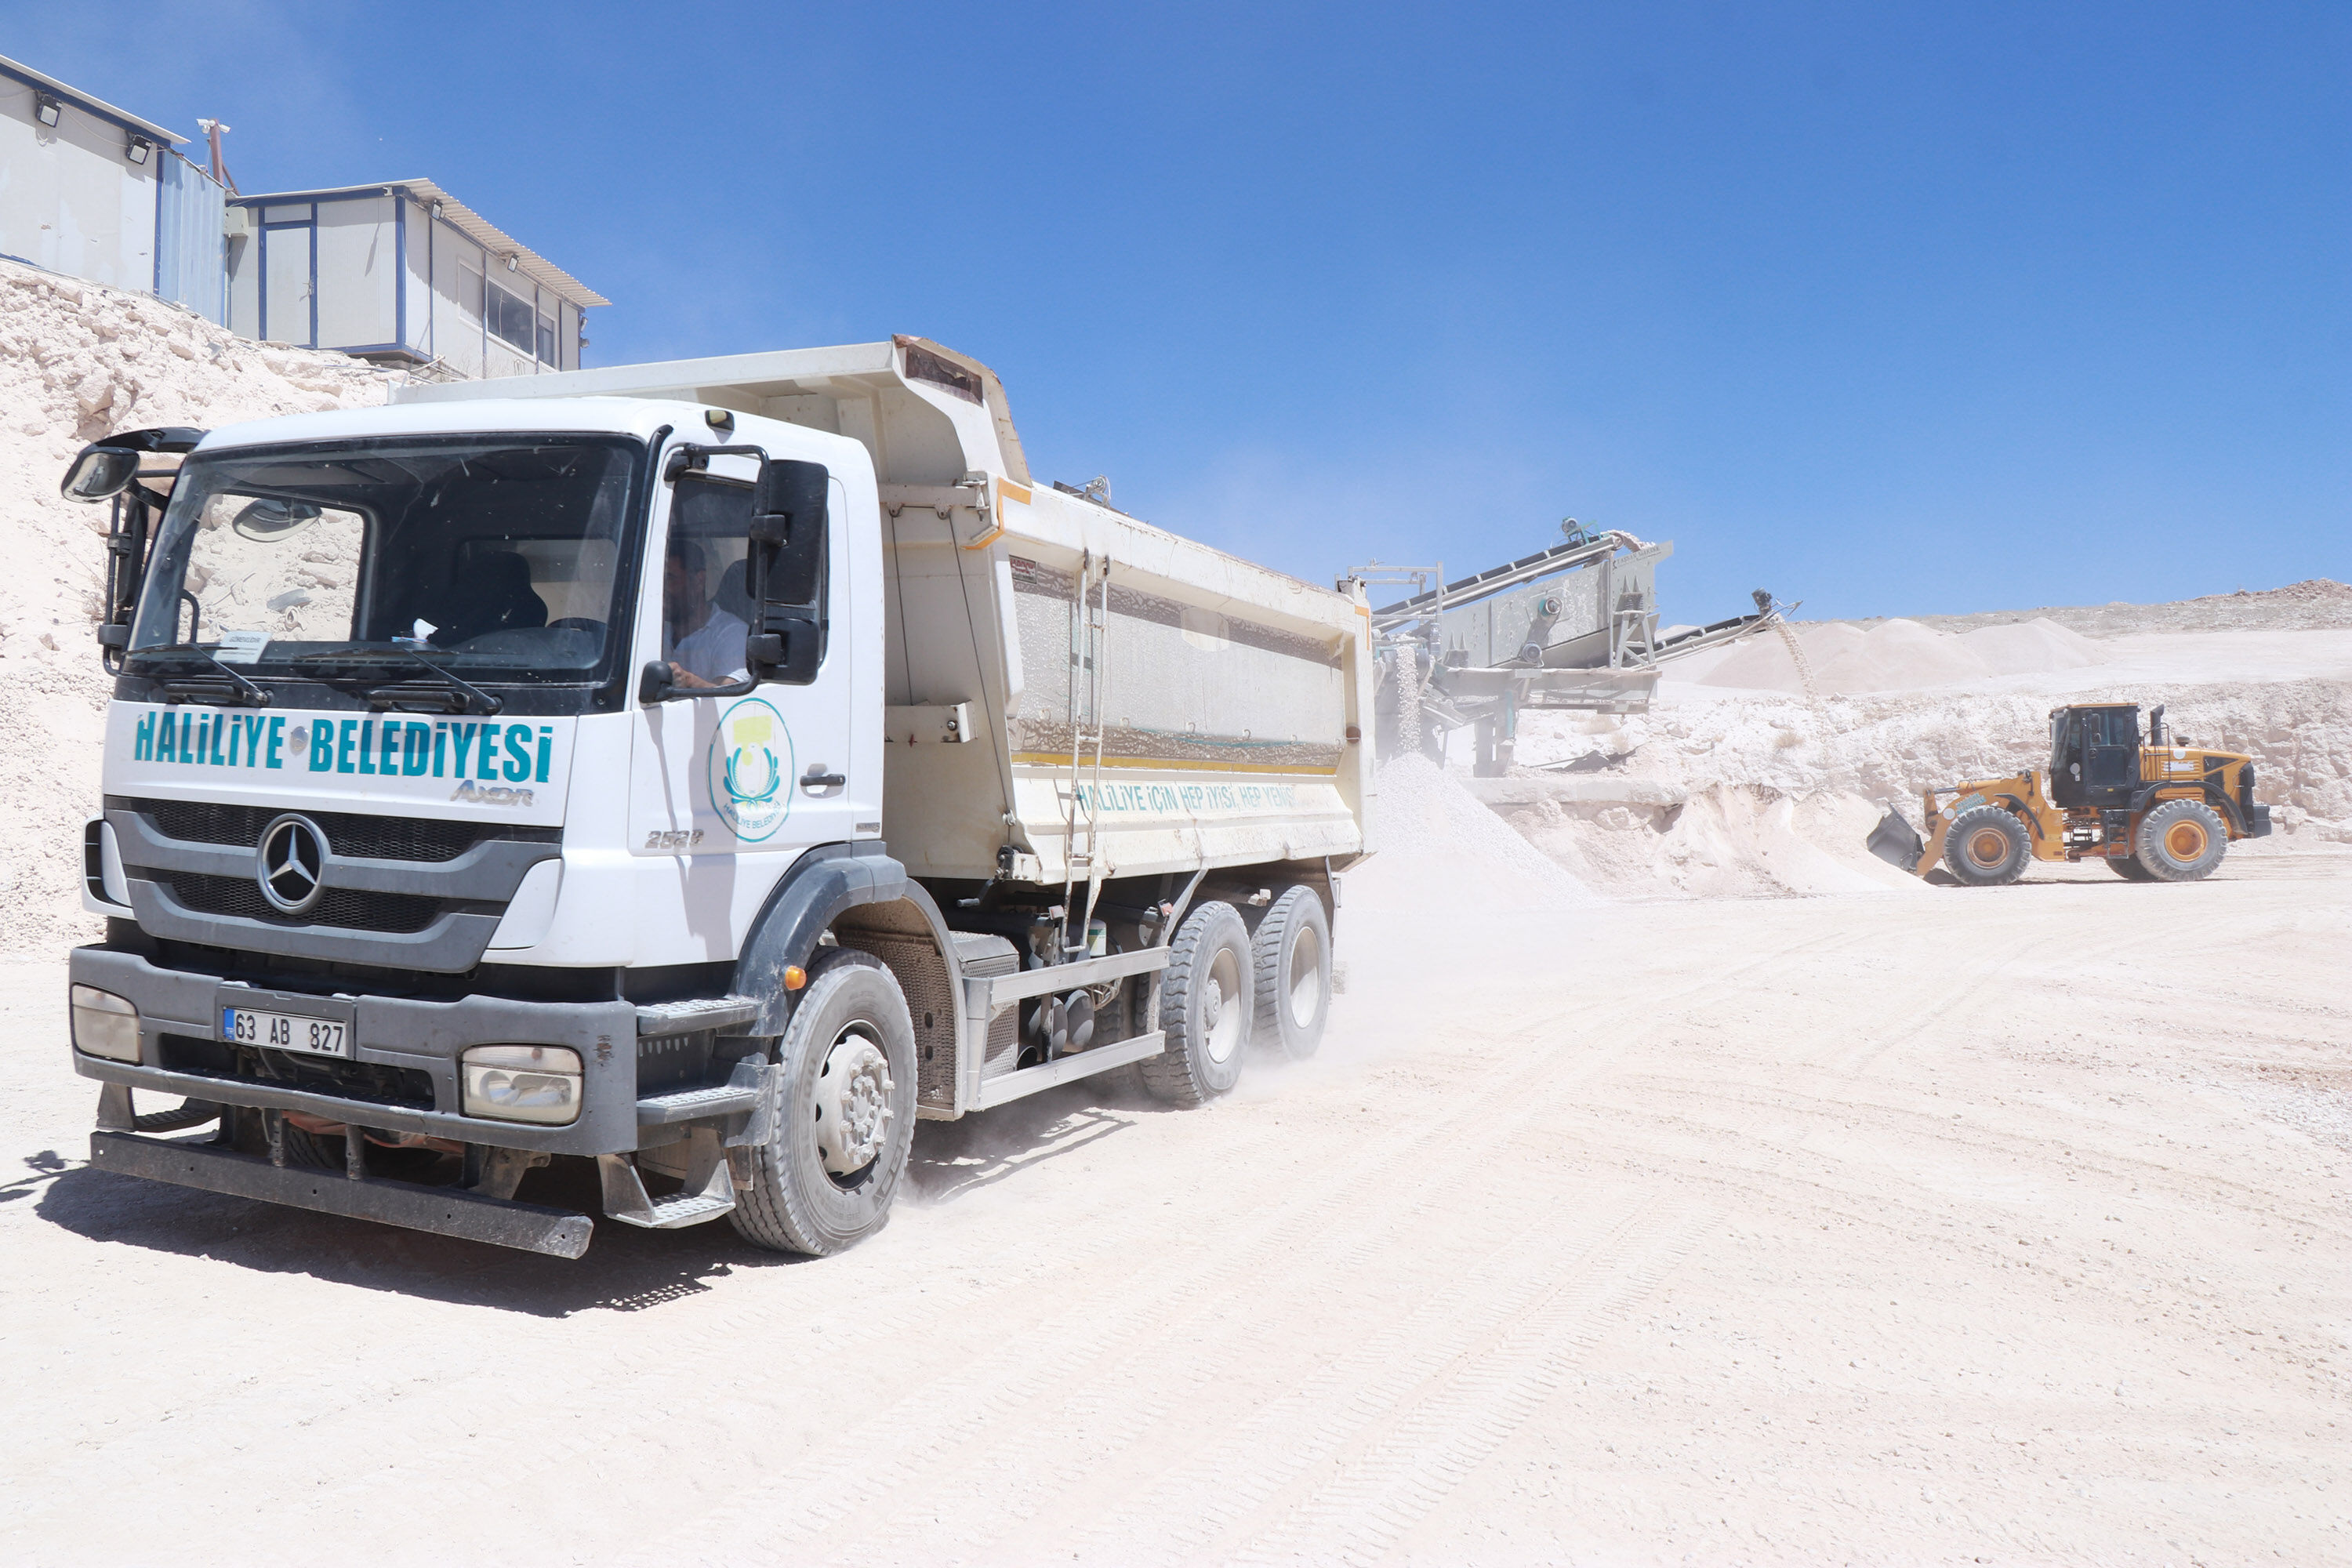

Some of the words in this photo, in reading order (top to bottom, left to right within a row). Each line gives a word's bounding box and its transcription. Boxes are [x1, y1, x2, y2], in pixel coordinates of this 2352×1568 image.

[135, 711, 285, 769] HALİLİYE
[309, 718, 553, 782] BELEDİYESİ
[1146, 786, 1179, 815] İÇİN
[1178, 786, 1203, 810] HEP
[1239, 786, 1261, 808] HEP
[236, 1014, 256, 1040] 63
[270, 1018, 290, 1045] AB
[310, 1022, 343, 1052] 827
